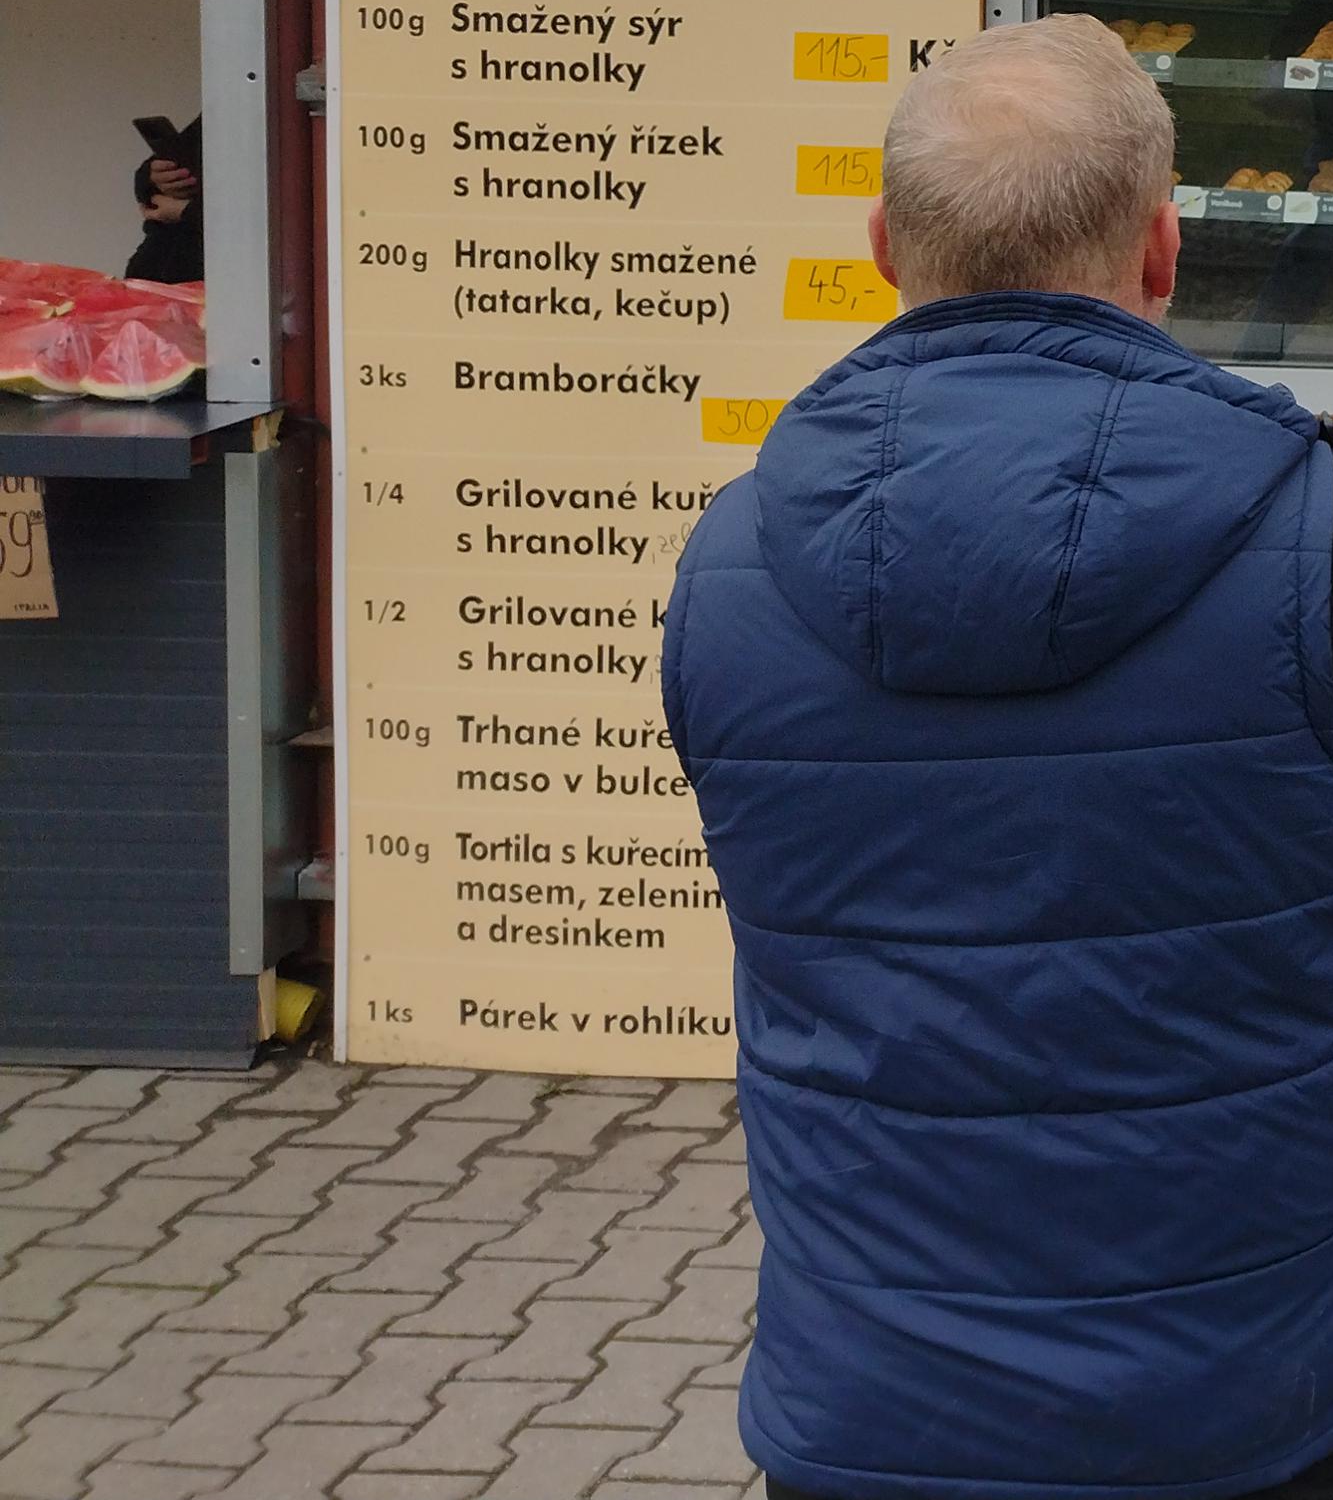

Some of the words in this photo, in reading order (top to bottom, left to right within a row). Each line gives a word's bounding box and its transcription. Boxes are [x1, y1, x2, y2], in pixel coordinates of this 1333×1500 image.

[451, 3, 615, 49] Smažený
[629, 8, 683, 46] sýr
[452, 59, 467, 80] s
[481, 51, 646, 92] hranolky
[452, 121, 616, 162] Smažený
[630, 125, 724, 157] řízek
[454, 177, 469, 197] s
[484, 169, 647, 210] hranolky
[456, 239, 600, 280] Hranolky
[610, 245, 757, 275] smažené
[454, 285, 603, 321] (tatarka,
[615, 289, 731, 325] kečup)
[807, 265, 876, 312] 45,-
[456, 361, 701, 403] Bramboráčky
[363, 481, 404, 506] 1/4
[456, 479, 638, 510] Grilované
[457, 533, 472, 553] s
[486, 524, 650, 565] hranolky
[364, 600, 406, 624] 1/2
[459, 596, 637, 629] Grilované
[458, 651, 473, 671] s
[487, 642, 648, 684] hranolky
[457, 714, 581, 747] Trhané
[457, 770, 551, 793] maso
[564, 774, 583, 794] v
[596, 762, 689, 796] bulce
[456, 832, 551, 864] Tortila
[562, 845, 575, 865] s
[457, 879, 587, 911] masem,
[457, 921, 476, 941] a
[488, 916, 666, 949] dresinkem
[459, 998, 559, 1034] Párek
[571, 1014, 590, 1033] v
[603, 1003, 732, 1037] rohlíku
